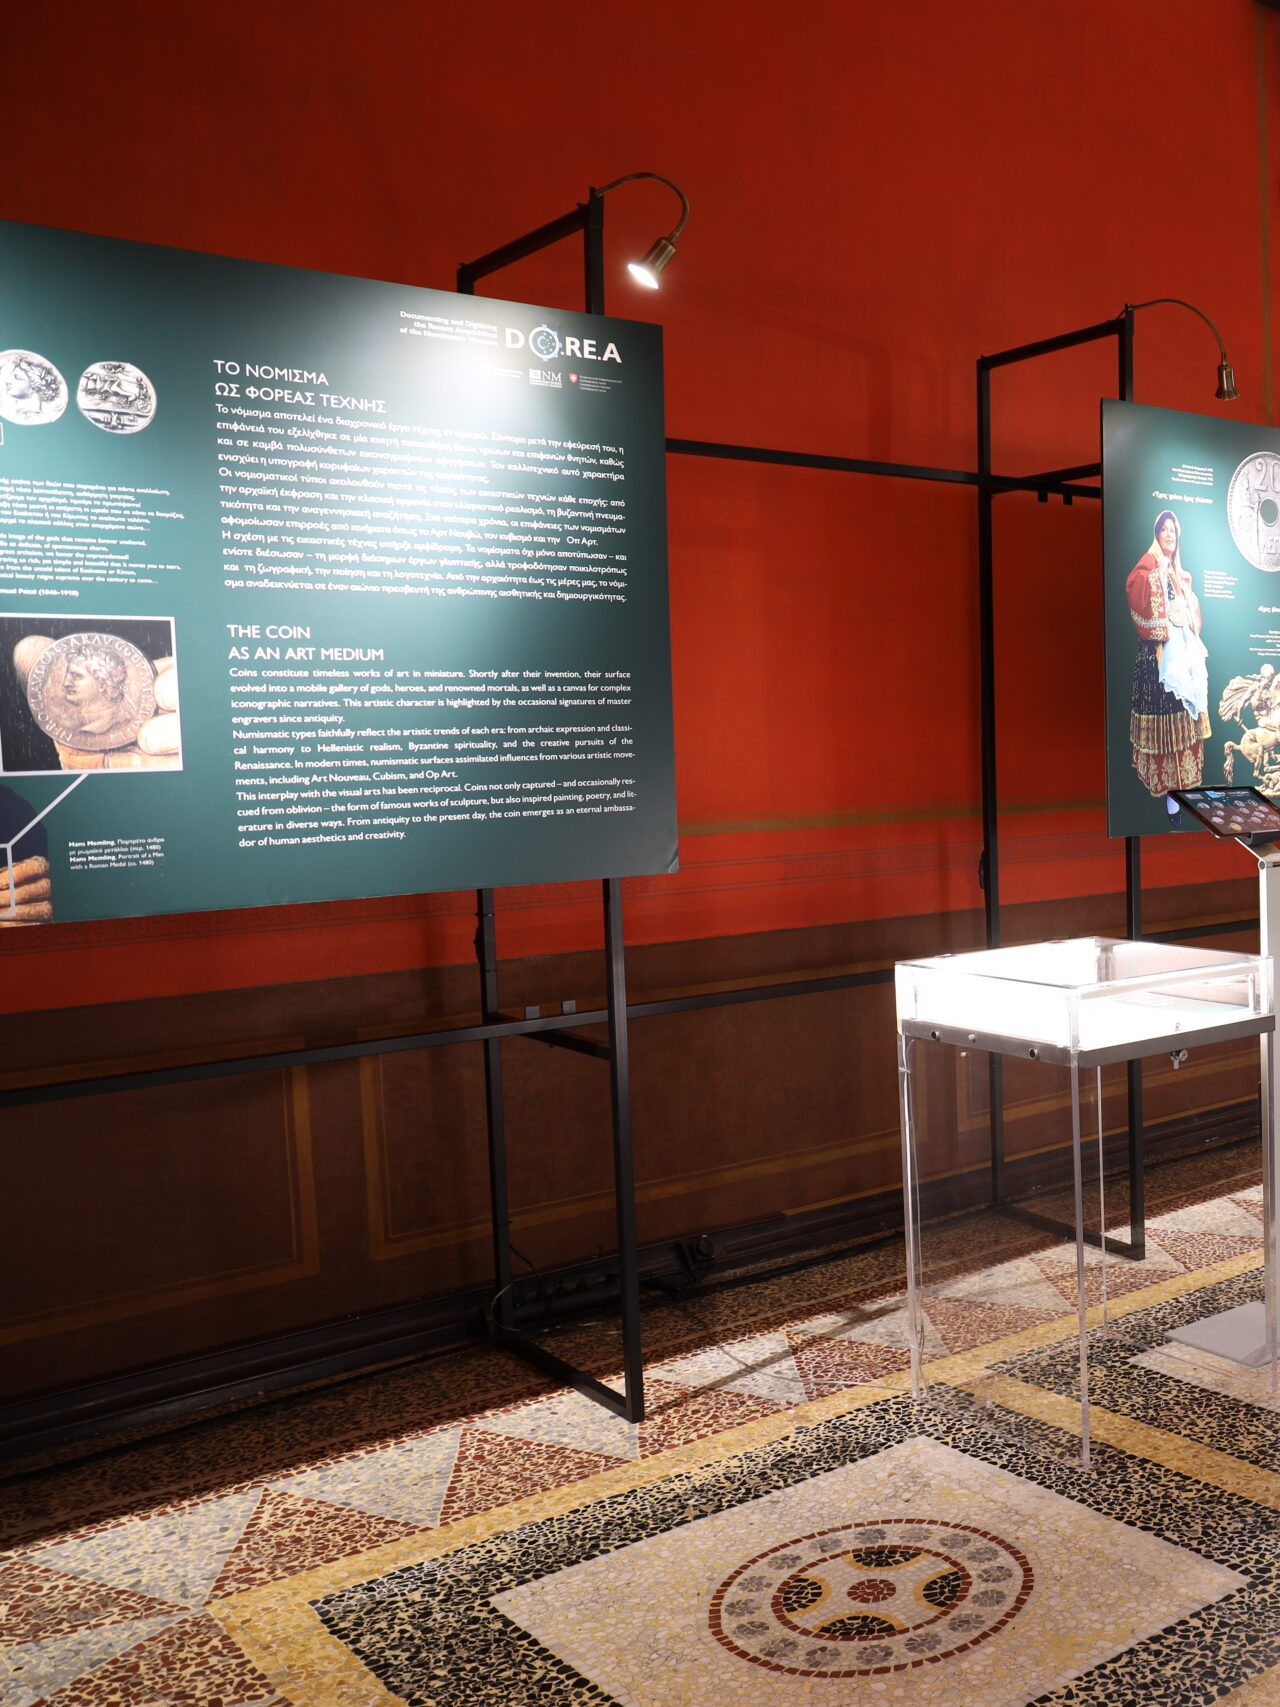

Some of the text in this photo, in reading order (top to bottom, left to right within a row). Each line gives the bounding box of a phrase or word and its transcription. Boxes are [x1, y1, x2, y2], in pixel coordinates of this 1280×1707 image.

[213, 359, 329, 386] ΤΟ ΝΟΜΙΣΜΑ
[214, 382, 387, 413] ΩΣ ΦΟΡΕΑΣ ΤΕΧΝΗΣ
[226, 624, 311, 639] THE COIN
[227, 646, 385, 661] AS AN ART MEDIUM
[228, 666, 630, 680] Coins constitute timeless works of art in miniature. Shortly after their invention, their surface
[231, 712, 345, 726] engravers since antiquity.
[233, 736, 632, 755] cal harmony to Hellenistic realism, Byzantine spirituality, and the creative pursuits of the
[235, 768, 458, 785] ments, including Art Nouveau, Cubism, and Op Art.
[238, 829, 407, 846] dor of human aesthetics and creativity.
